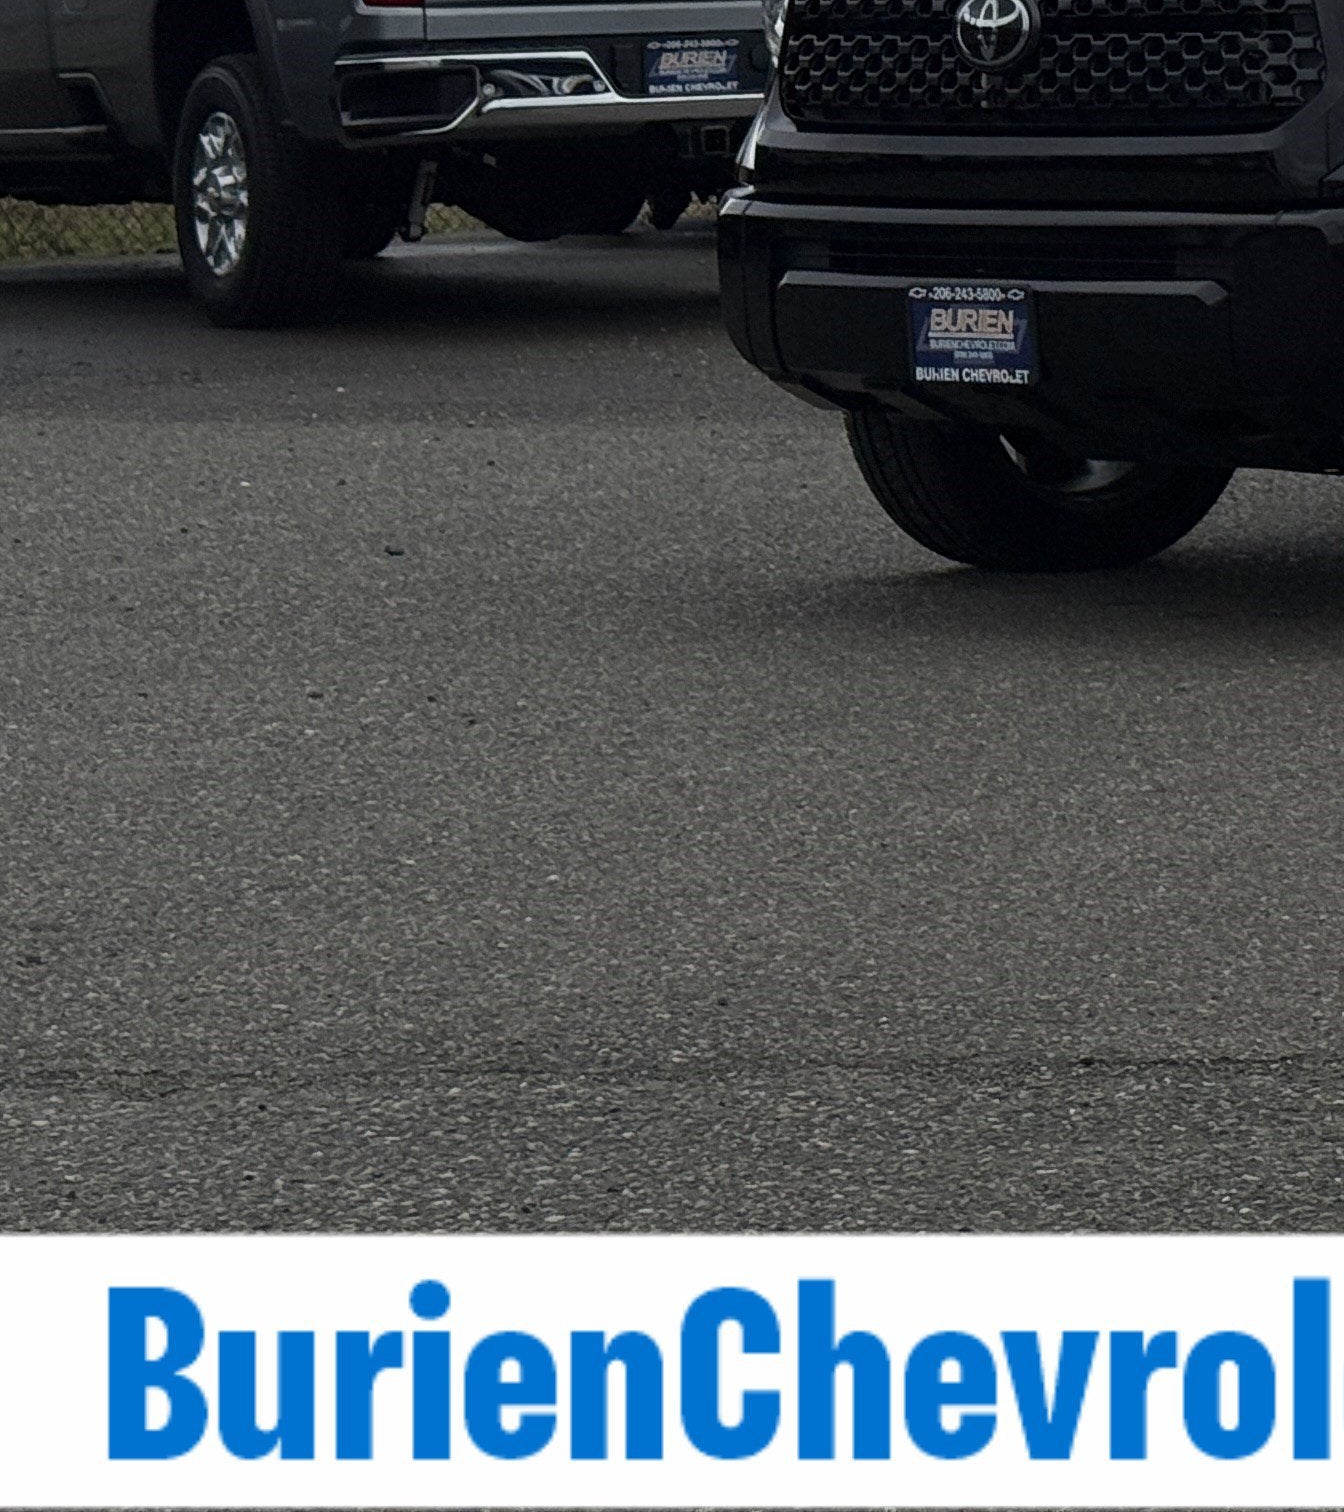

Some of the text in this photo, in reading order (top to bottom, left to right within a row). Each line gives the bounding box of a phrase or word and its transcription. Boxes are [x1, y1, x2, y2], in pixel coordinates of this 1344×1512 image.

[660, 50, 728, 69] BURIEN
[931, 286, 1003, 301] 206-243-5800
[930, 307, 1015, 333] BURIEN
